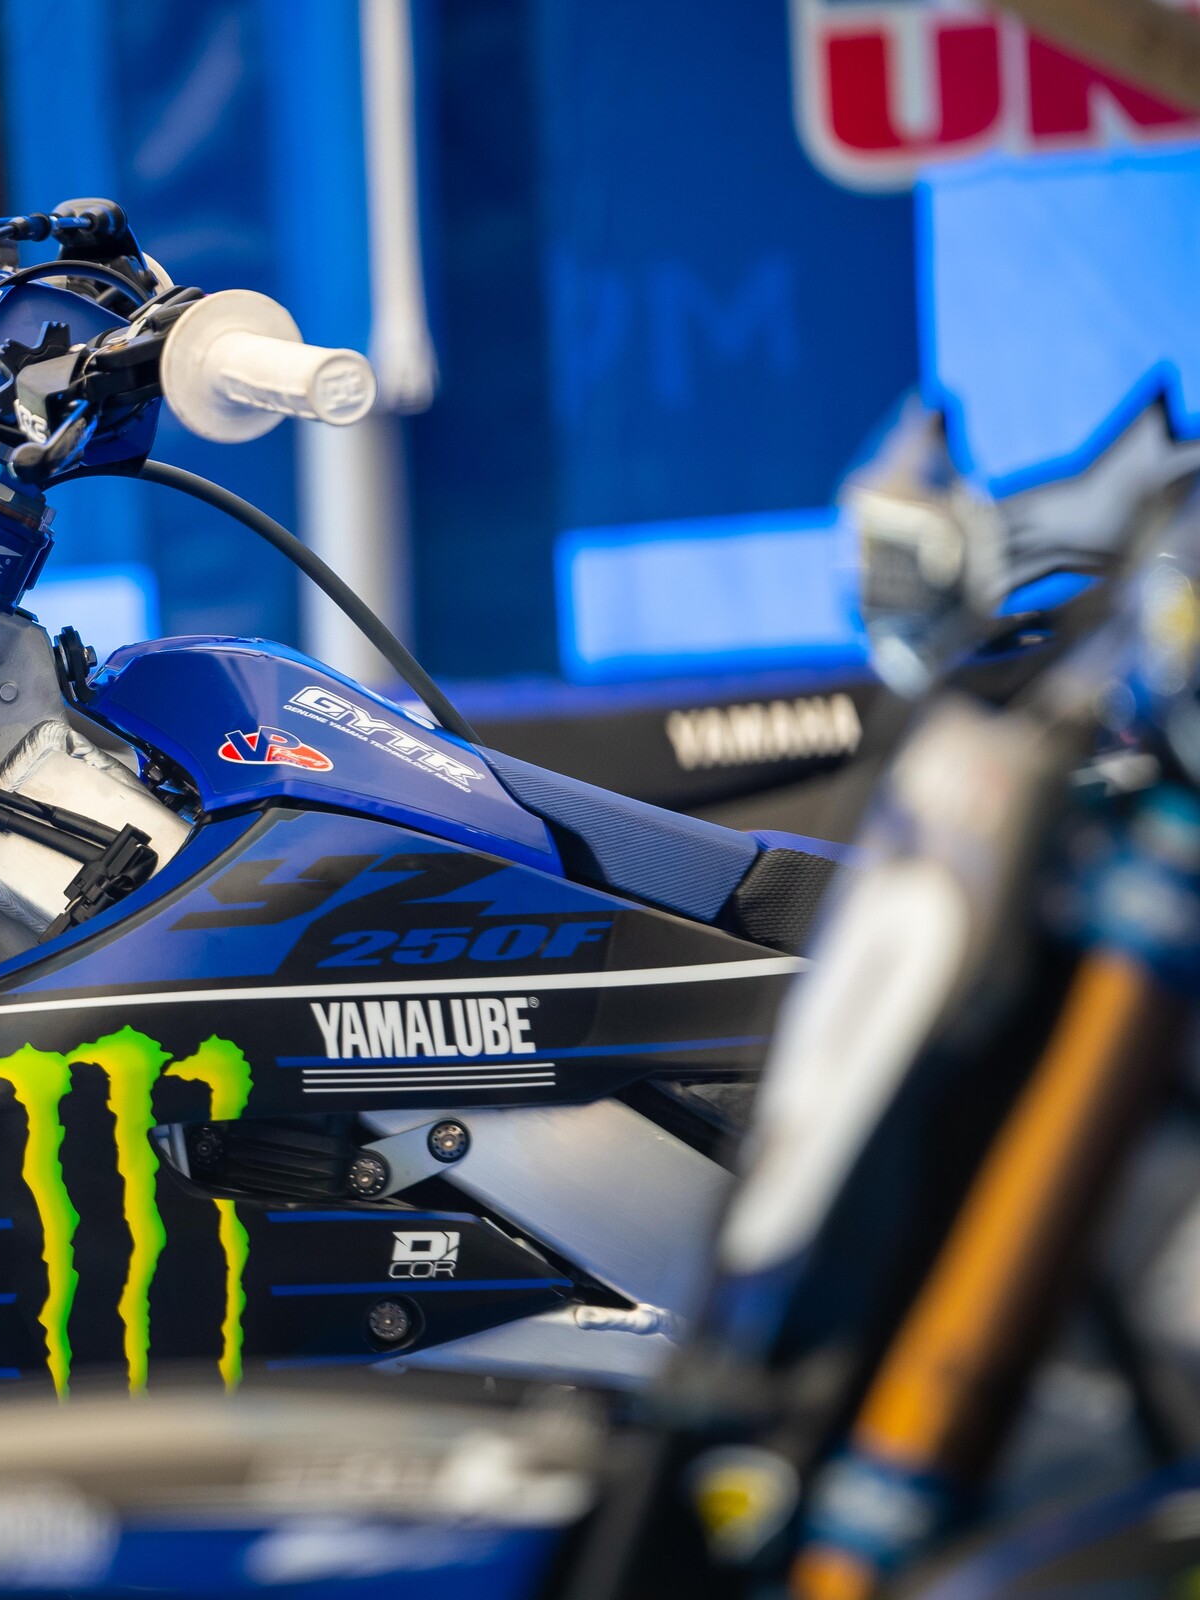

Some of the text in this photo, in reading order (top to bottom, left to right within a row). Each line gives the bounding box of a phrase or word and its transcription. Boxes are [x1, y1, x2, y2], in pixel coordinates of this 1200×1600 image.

[224, 725, 303, 763] VP
[283, 703, 472, 794] GENUINE YAMAHA TECHNOLOGY RACING
[288, 683, 482, 787] GYTR
[315, 920, 614, 969] 250F
[309, 997, 537, 1060] YAMALUBE
[388, 1261, 456, 1278] COR
